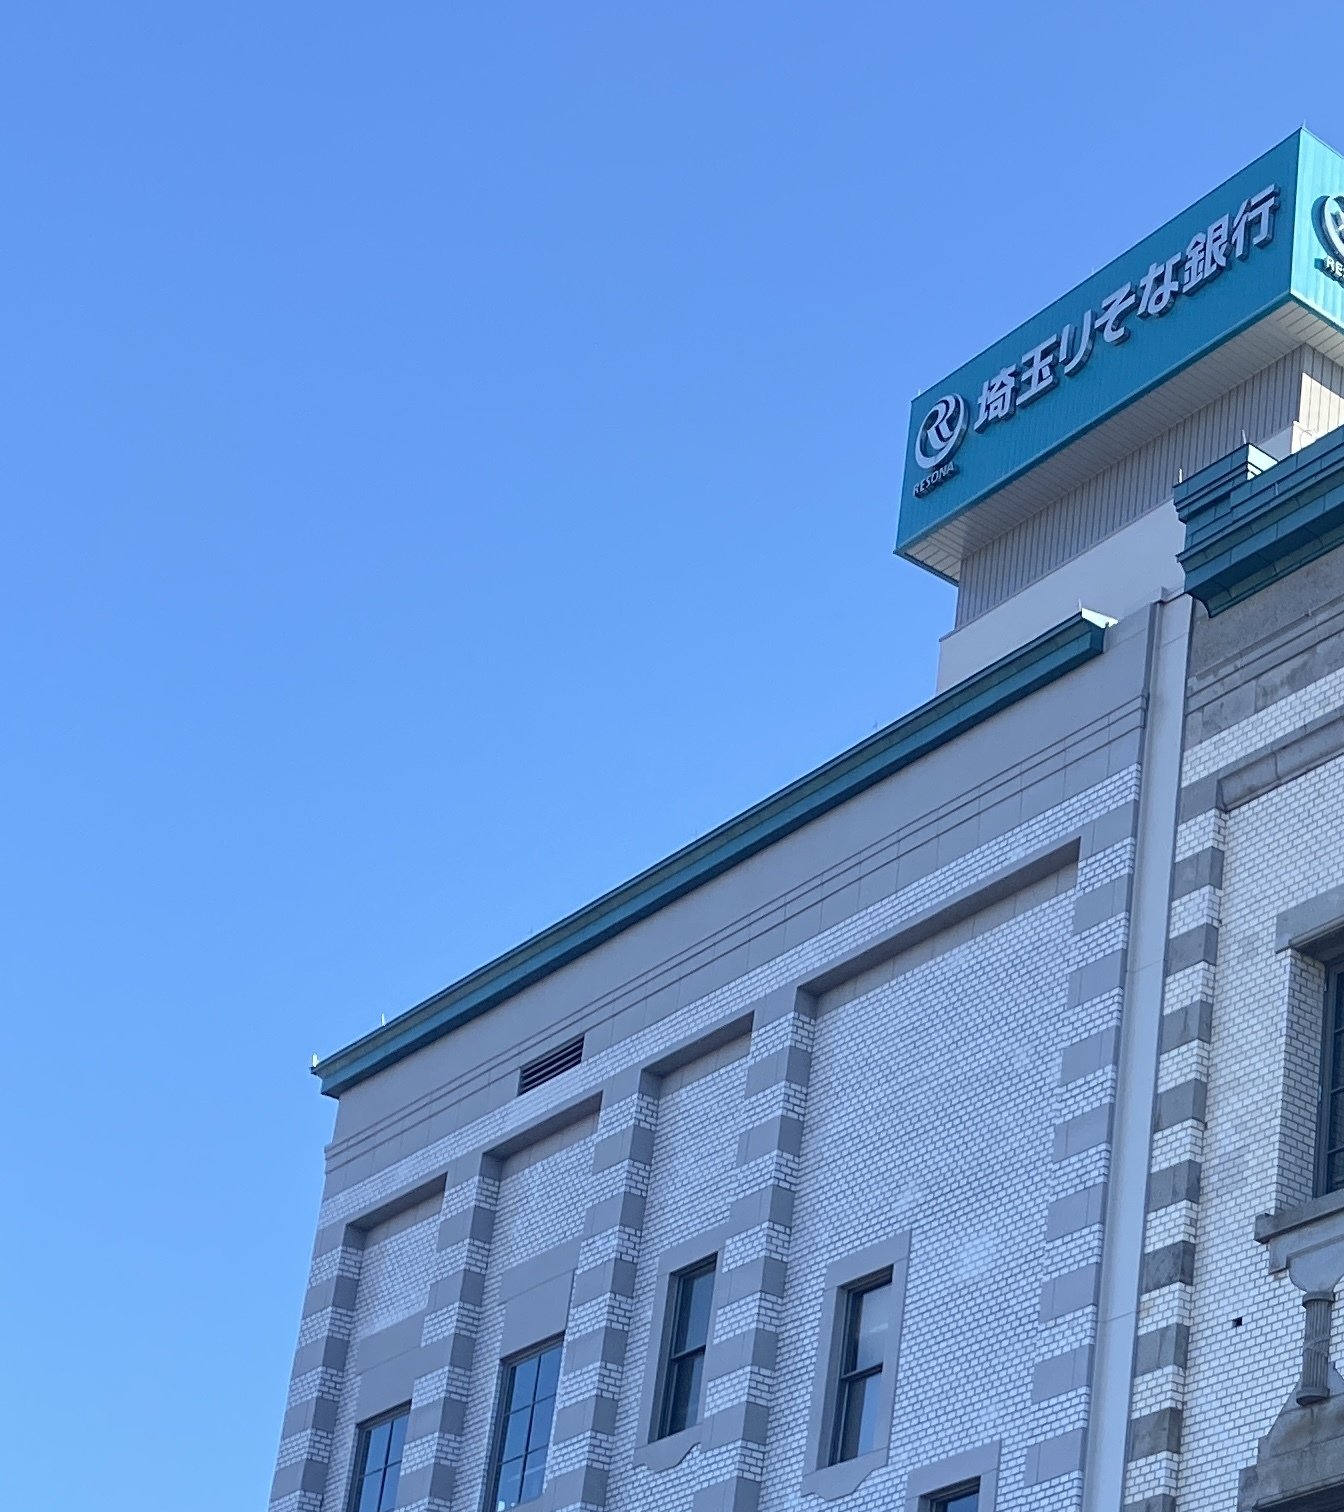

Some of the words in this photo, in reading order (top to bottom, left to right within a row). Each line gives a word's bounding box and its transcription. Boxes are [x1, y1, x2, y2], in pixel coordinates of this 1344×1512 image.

[973, 183, 1279, 431] 埼玉りそな銀行
[912, 461, 955, 497] RESONA
